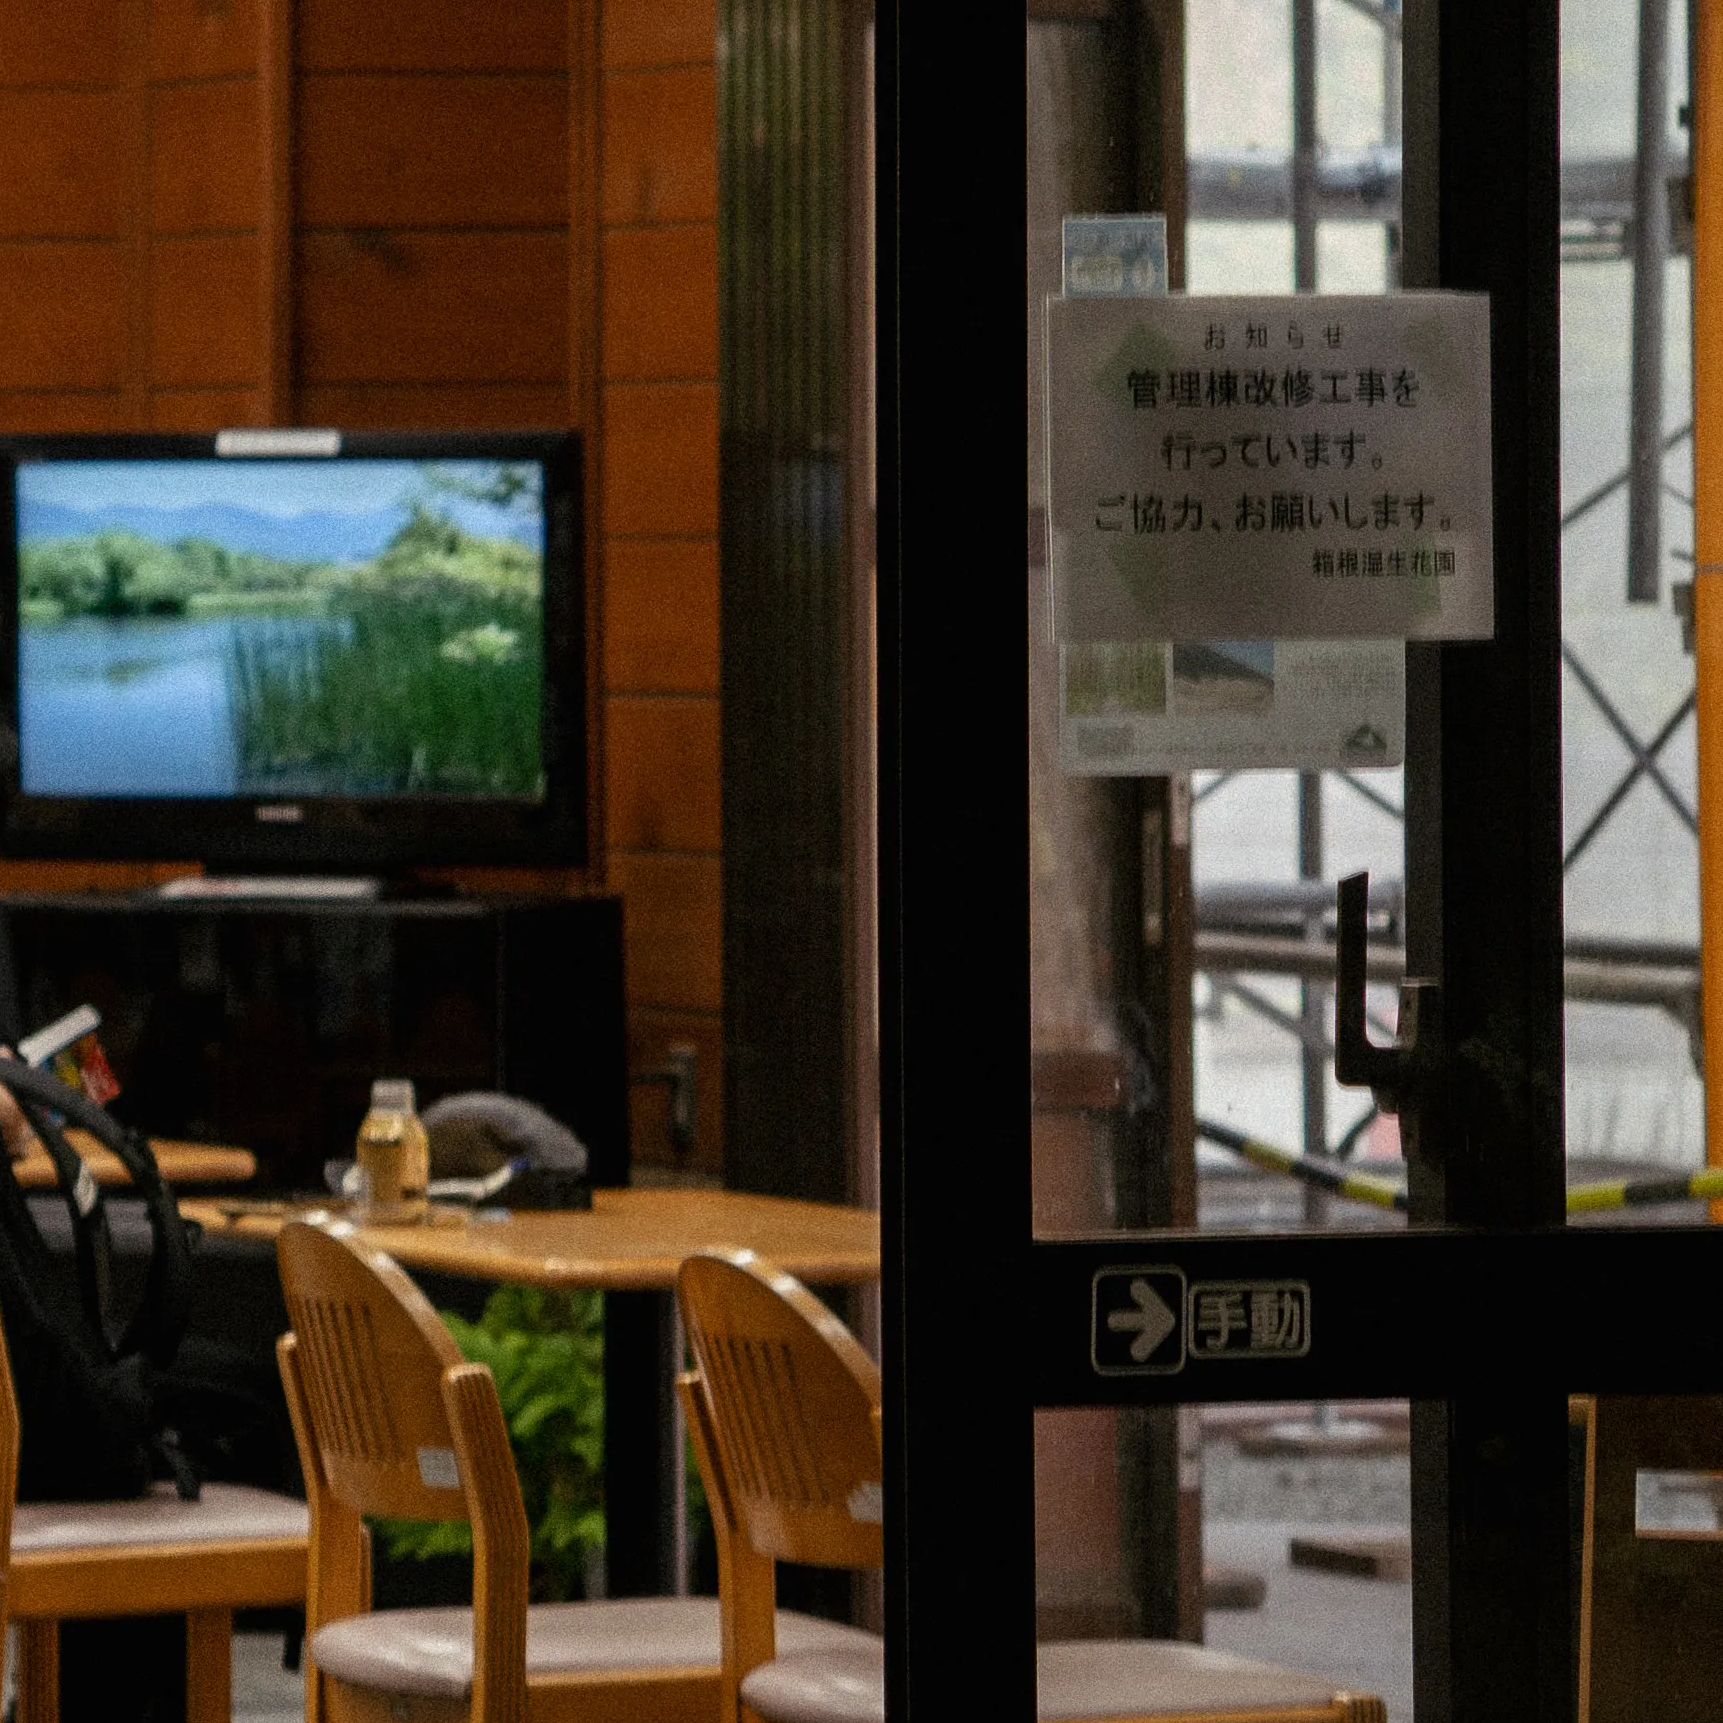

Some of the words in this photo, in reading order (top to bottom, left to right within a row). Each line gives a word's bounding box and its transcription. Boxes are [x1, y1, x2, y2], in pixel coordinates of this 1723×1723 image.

[1203, 321, 1346, 351] お知らせ
[1126, 368, 1421, 409] 管理棟改修工事を
[1161, 429, 1385, 473] 行っています。
[1094, 490, 1455, 535] ご協力、お願いします。
[1197, 1289, 1302, 1351] 手動
